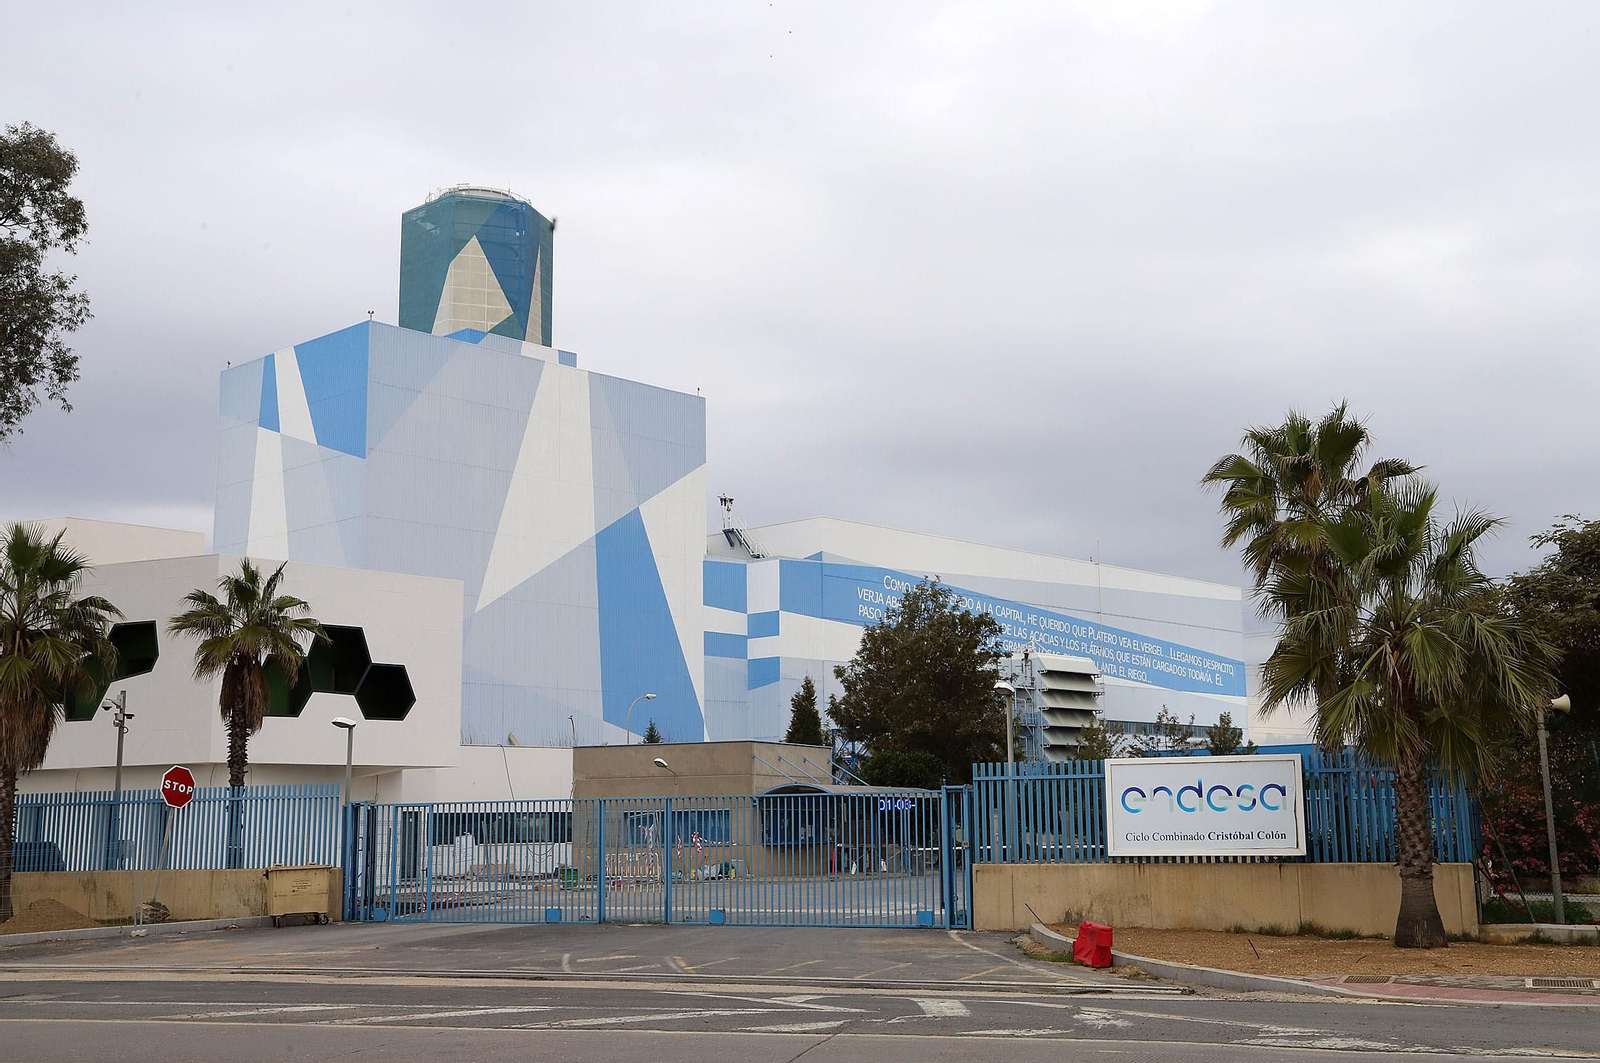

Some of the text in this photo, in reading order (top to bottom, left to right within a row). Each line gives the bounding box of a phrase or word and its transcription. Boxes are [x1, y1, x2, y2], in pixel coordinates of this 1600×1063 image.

[857, 587, 884, 605] VERJA
[1013, 625, 1028, 640] LAS
[1030, 630, 1059, 647] ACACIAS
[1060, 636, 1065, 648] Y
[1066, 637, 1080, 651] LOS
[1116, 650, 1130, 663] QUE
[1132, 654, 1151, 668] ESTÁN
[1152, 659, 1187, 677] CARGADOS
[1215, 674, 1224, 687] EL
[858, 604, 882, 620] PASO
[1119, 666, 1127, 678] EL
[884, 575, 911, 594] COMO
[976, 601, 982, 612] A
[984, 602, 994, 615] LA
[996, 605, 1026, 625] CAPITAL,
[1028, 613, 1038, 626] HE
[1039, 616, 1071, 634] QUERIDO
[1072, 624, 1087, 638] QUE
[1088, 626, 1118, 645] PLATERO
[1119, 636, 1132, 649] VEA
[1133, 640, 1140, 652] EL
[1203, 658, 1235, 677] DESPACITO,
[164, 779, 193, 795] STOP
[1121, 778, 1287, 814] endesa
[1125, 830, 1287, 842] Ciclo Combinado Cristóbal Colón
